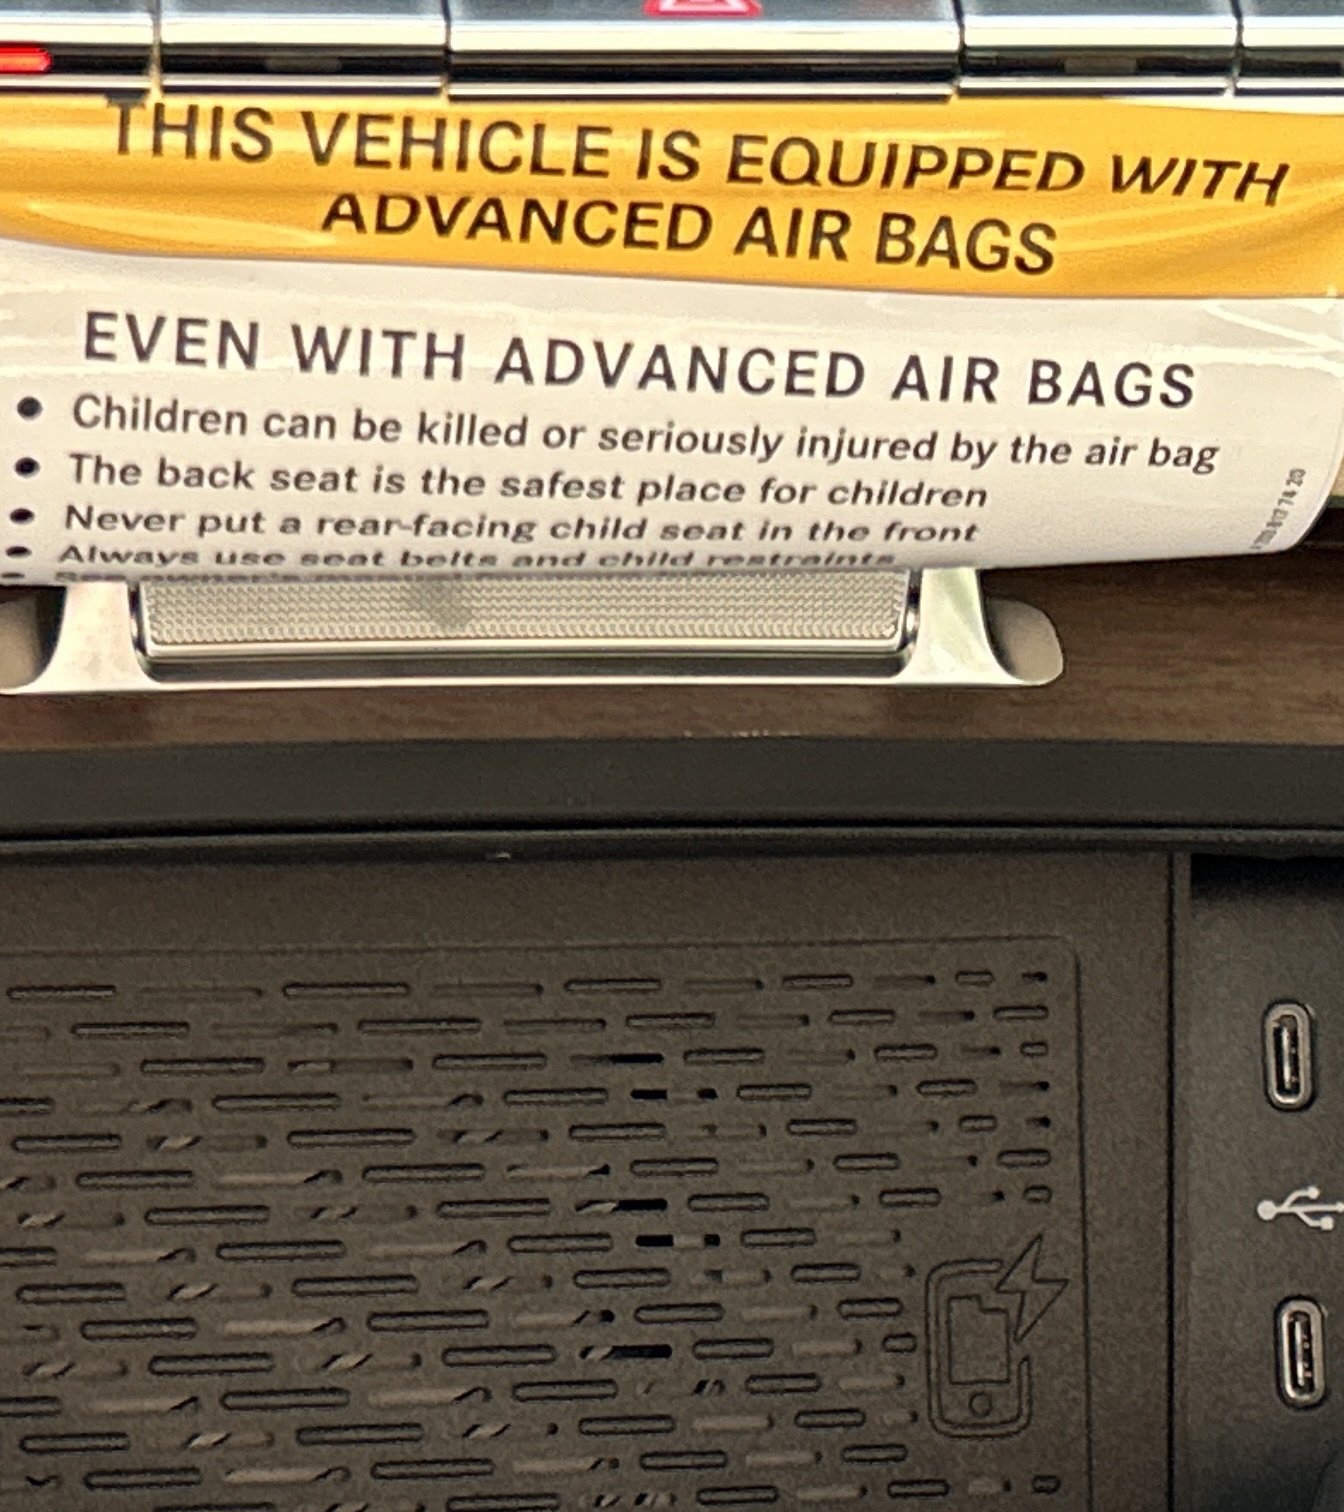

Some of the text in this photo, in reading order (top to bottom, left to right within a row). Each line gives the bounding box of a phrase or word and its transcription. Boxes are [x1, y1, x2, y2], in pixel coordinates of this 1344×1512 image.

[108, 100, 1291, 207] THIS VEHICLE IS EQUIPPED WITH
[321, 192, 1057, 276] ADVANCED AIR BAGS
[84, 310, 1194, 409] EVEN WITH ADVANCED AIR BAGS
[72, 392, 1220, 475] Children can be killed or seriously injured by the air bag
[69, 452, 988, 508] The back seat is the safest place for children
[58, 544, 897, 569] Always use seat belts and child restraints
[64, 504, 978, 544] Never put a rear-facing child seat in the front
